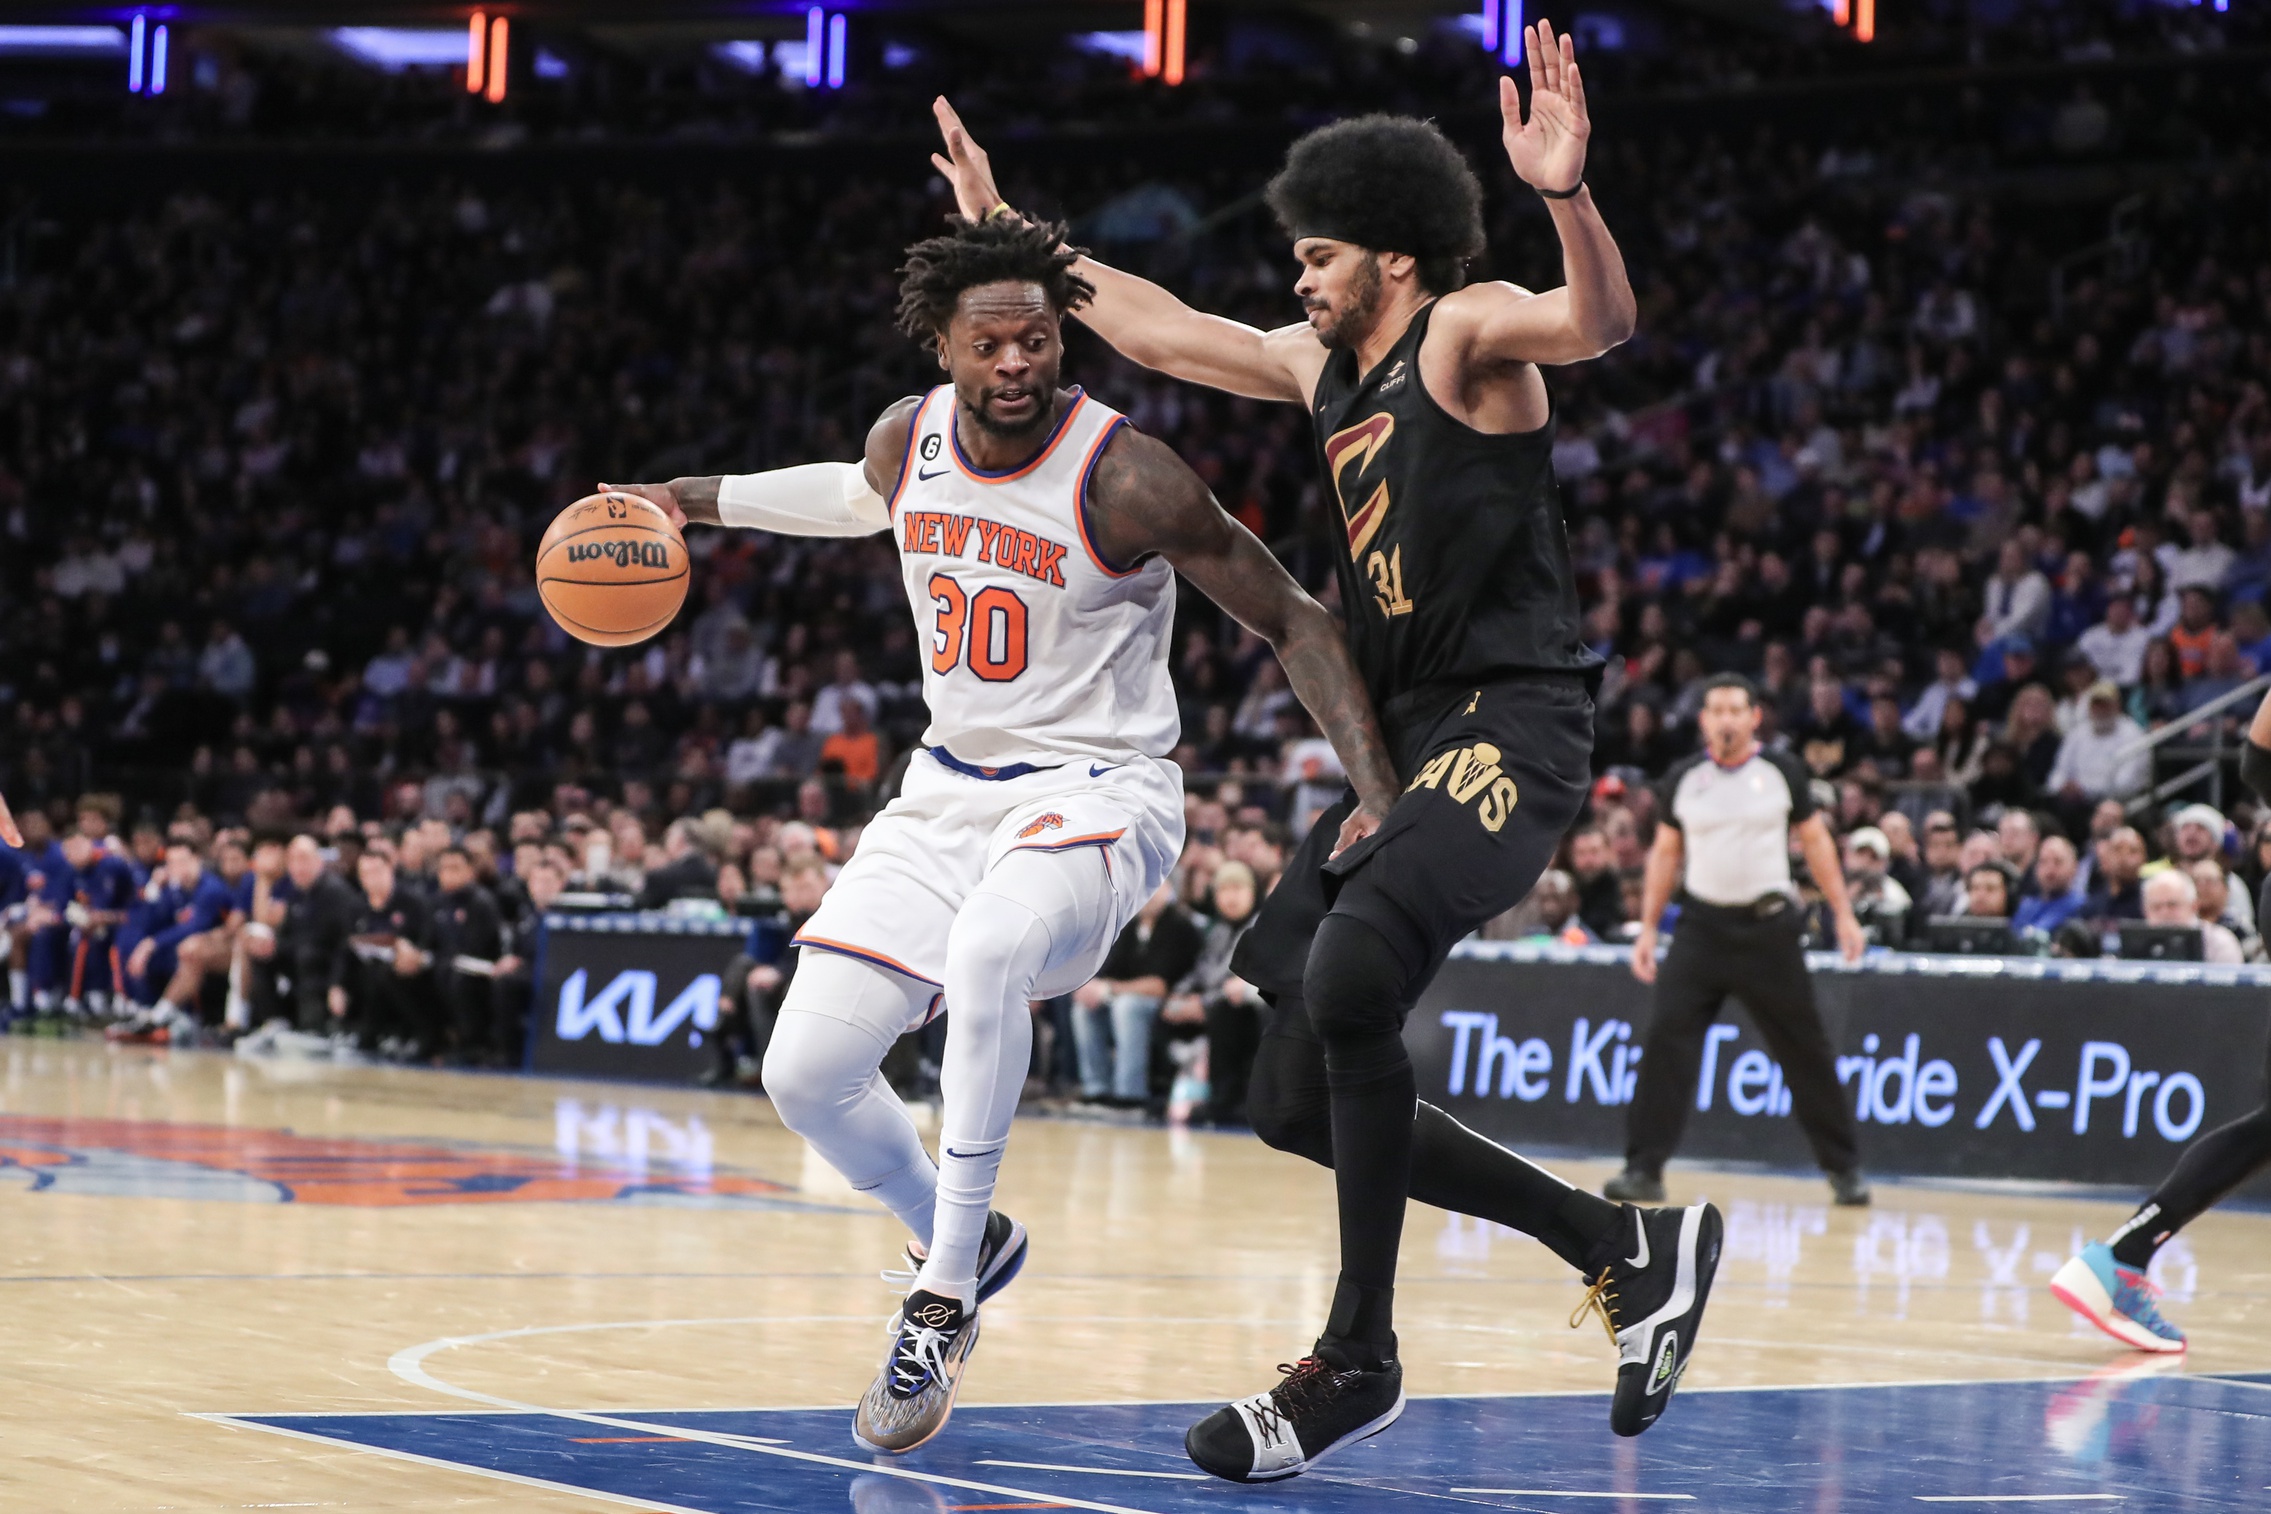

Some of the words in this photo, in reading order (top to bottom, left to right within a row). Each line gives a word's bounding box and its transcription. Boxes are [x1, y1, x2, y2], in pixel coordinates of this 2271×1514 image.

[1380, 373, 1406, 392] CLIFFS
[923, 434, 942, 461] 6
[566, 539, 670, 570] Wilson
[904, 511, 973, 557] NEW
[976, 516, 1069, 590] YORK
[1367, 542, 1414, 619] 31
[928, 572, 1029, 683] 30
[1401, 742, 1519, 832] AVS
[1441, 1010, 1552, 1101] The
[1974, 1035, 2205, 1142] X-Pro
